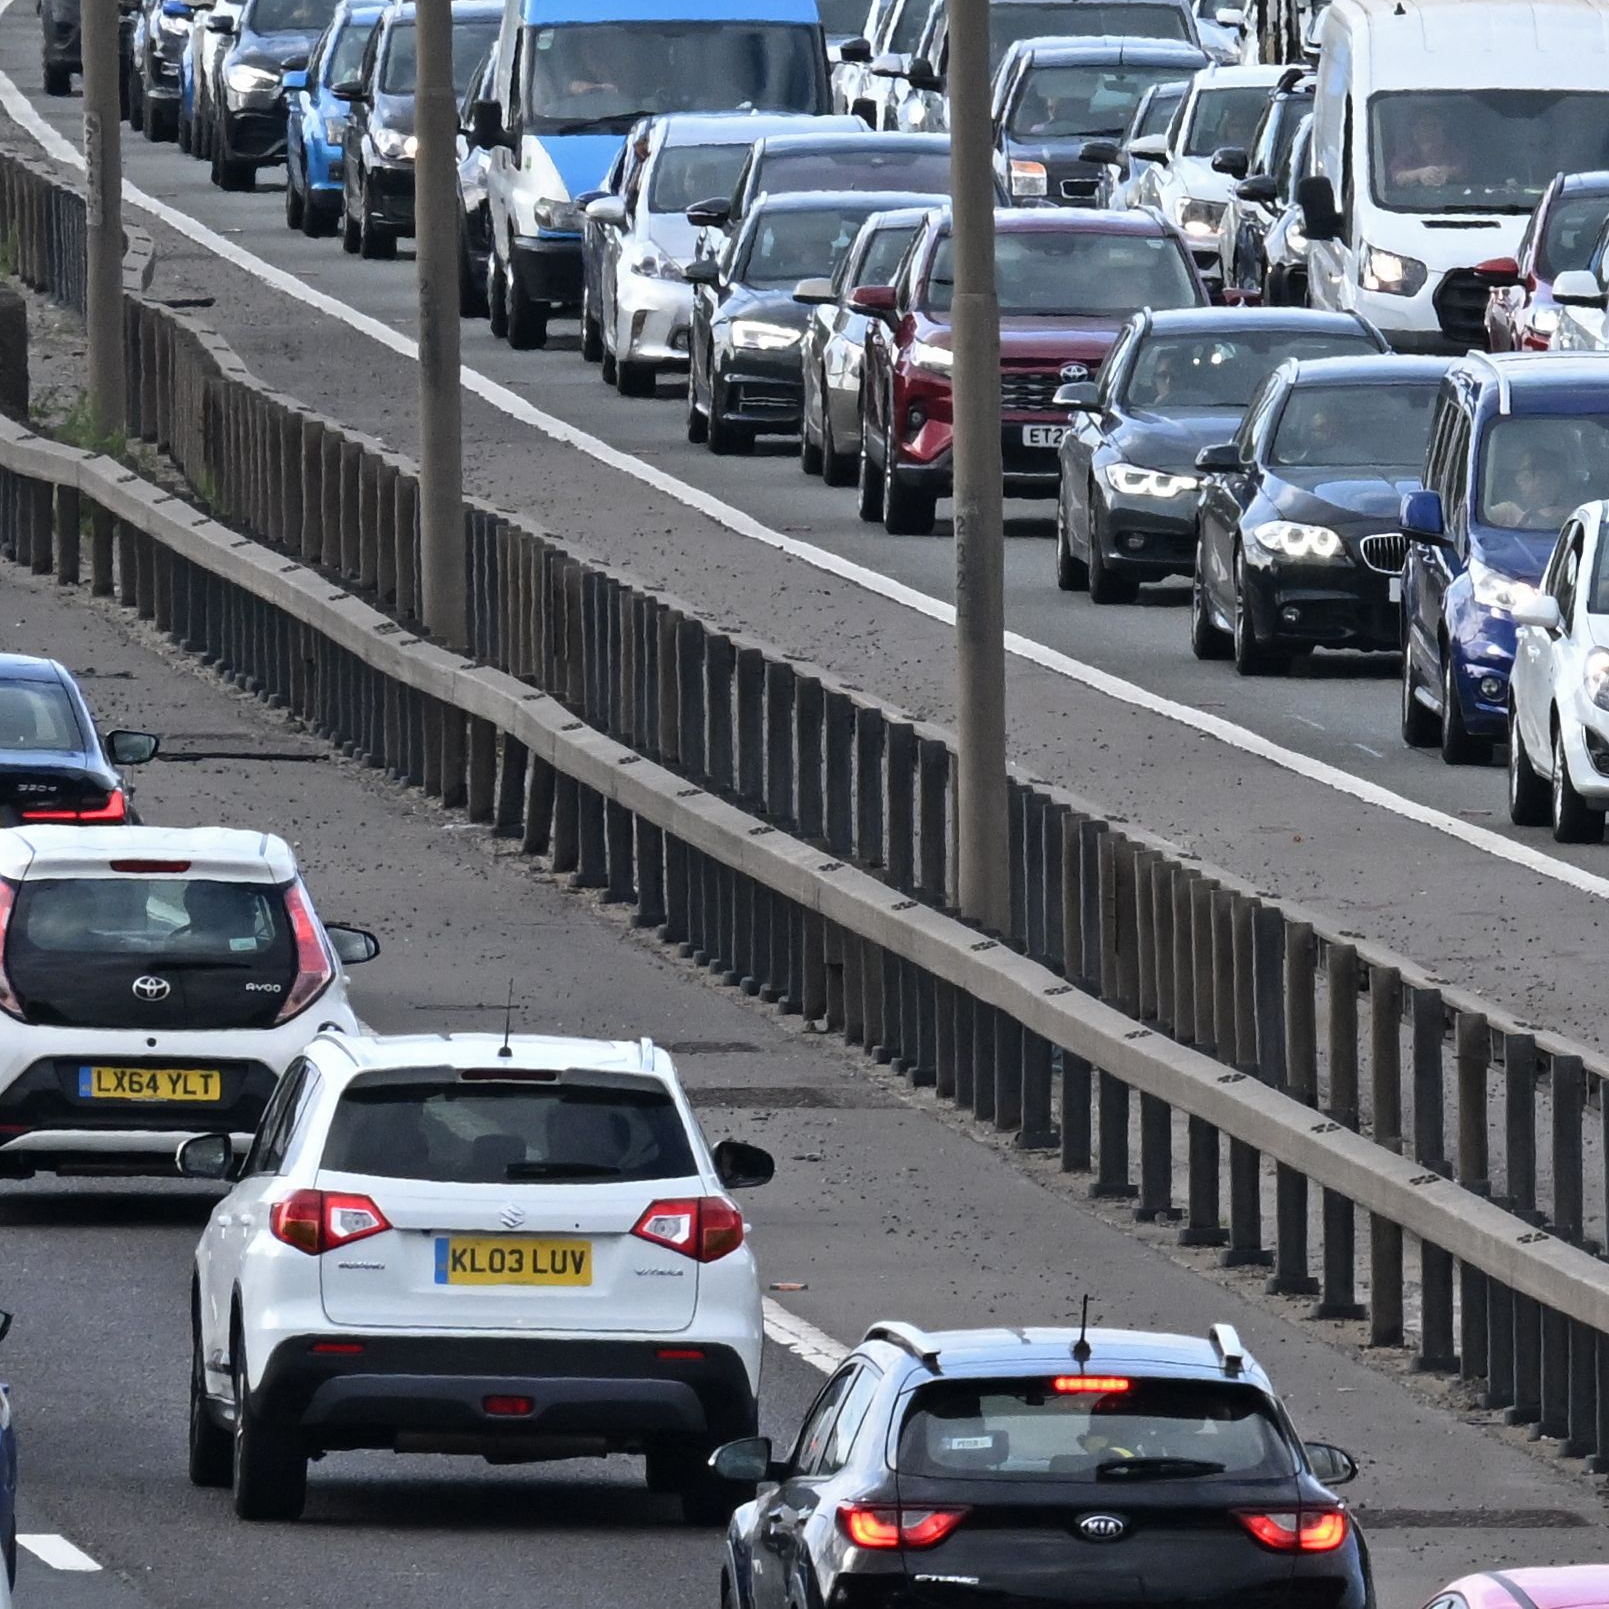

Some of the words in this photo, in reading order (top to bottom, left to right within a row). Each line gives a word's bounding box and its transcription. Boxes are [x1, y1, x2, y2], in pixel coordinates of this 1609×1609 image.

[1030, 427, 1067, 445] ET2
[245, 982, 282, 994] AYGO
[97, 1070, 160, 1094] LX64
[168, 1071, 214, 1096] YLT
[451, 1248, 525, 1275] KL03
[532, 1249, 585, 1275] LUV
[1086, 1521, 1117, 1536] KIA
